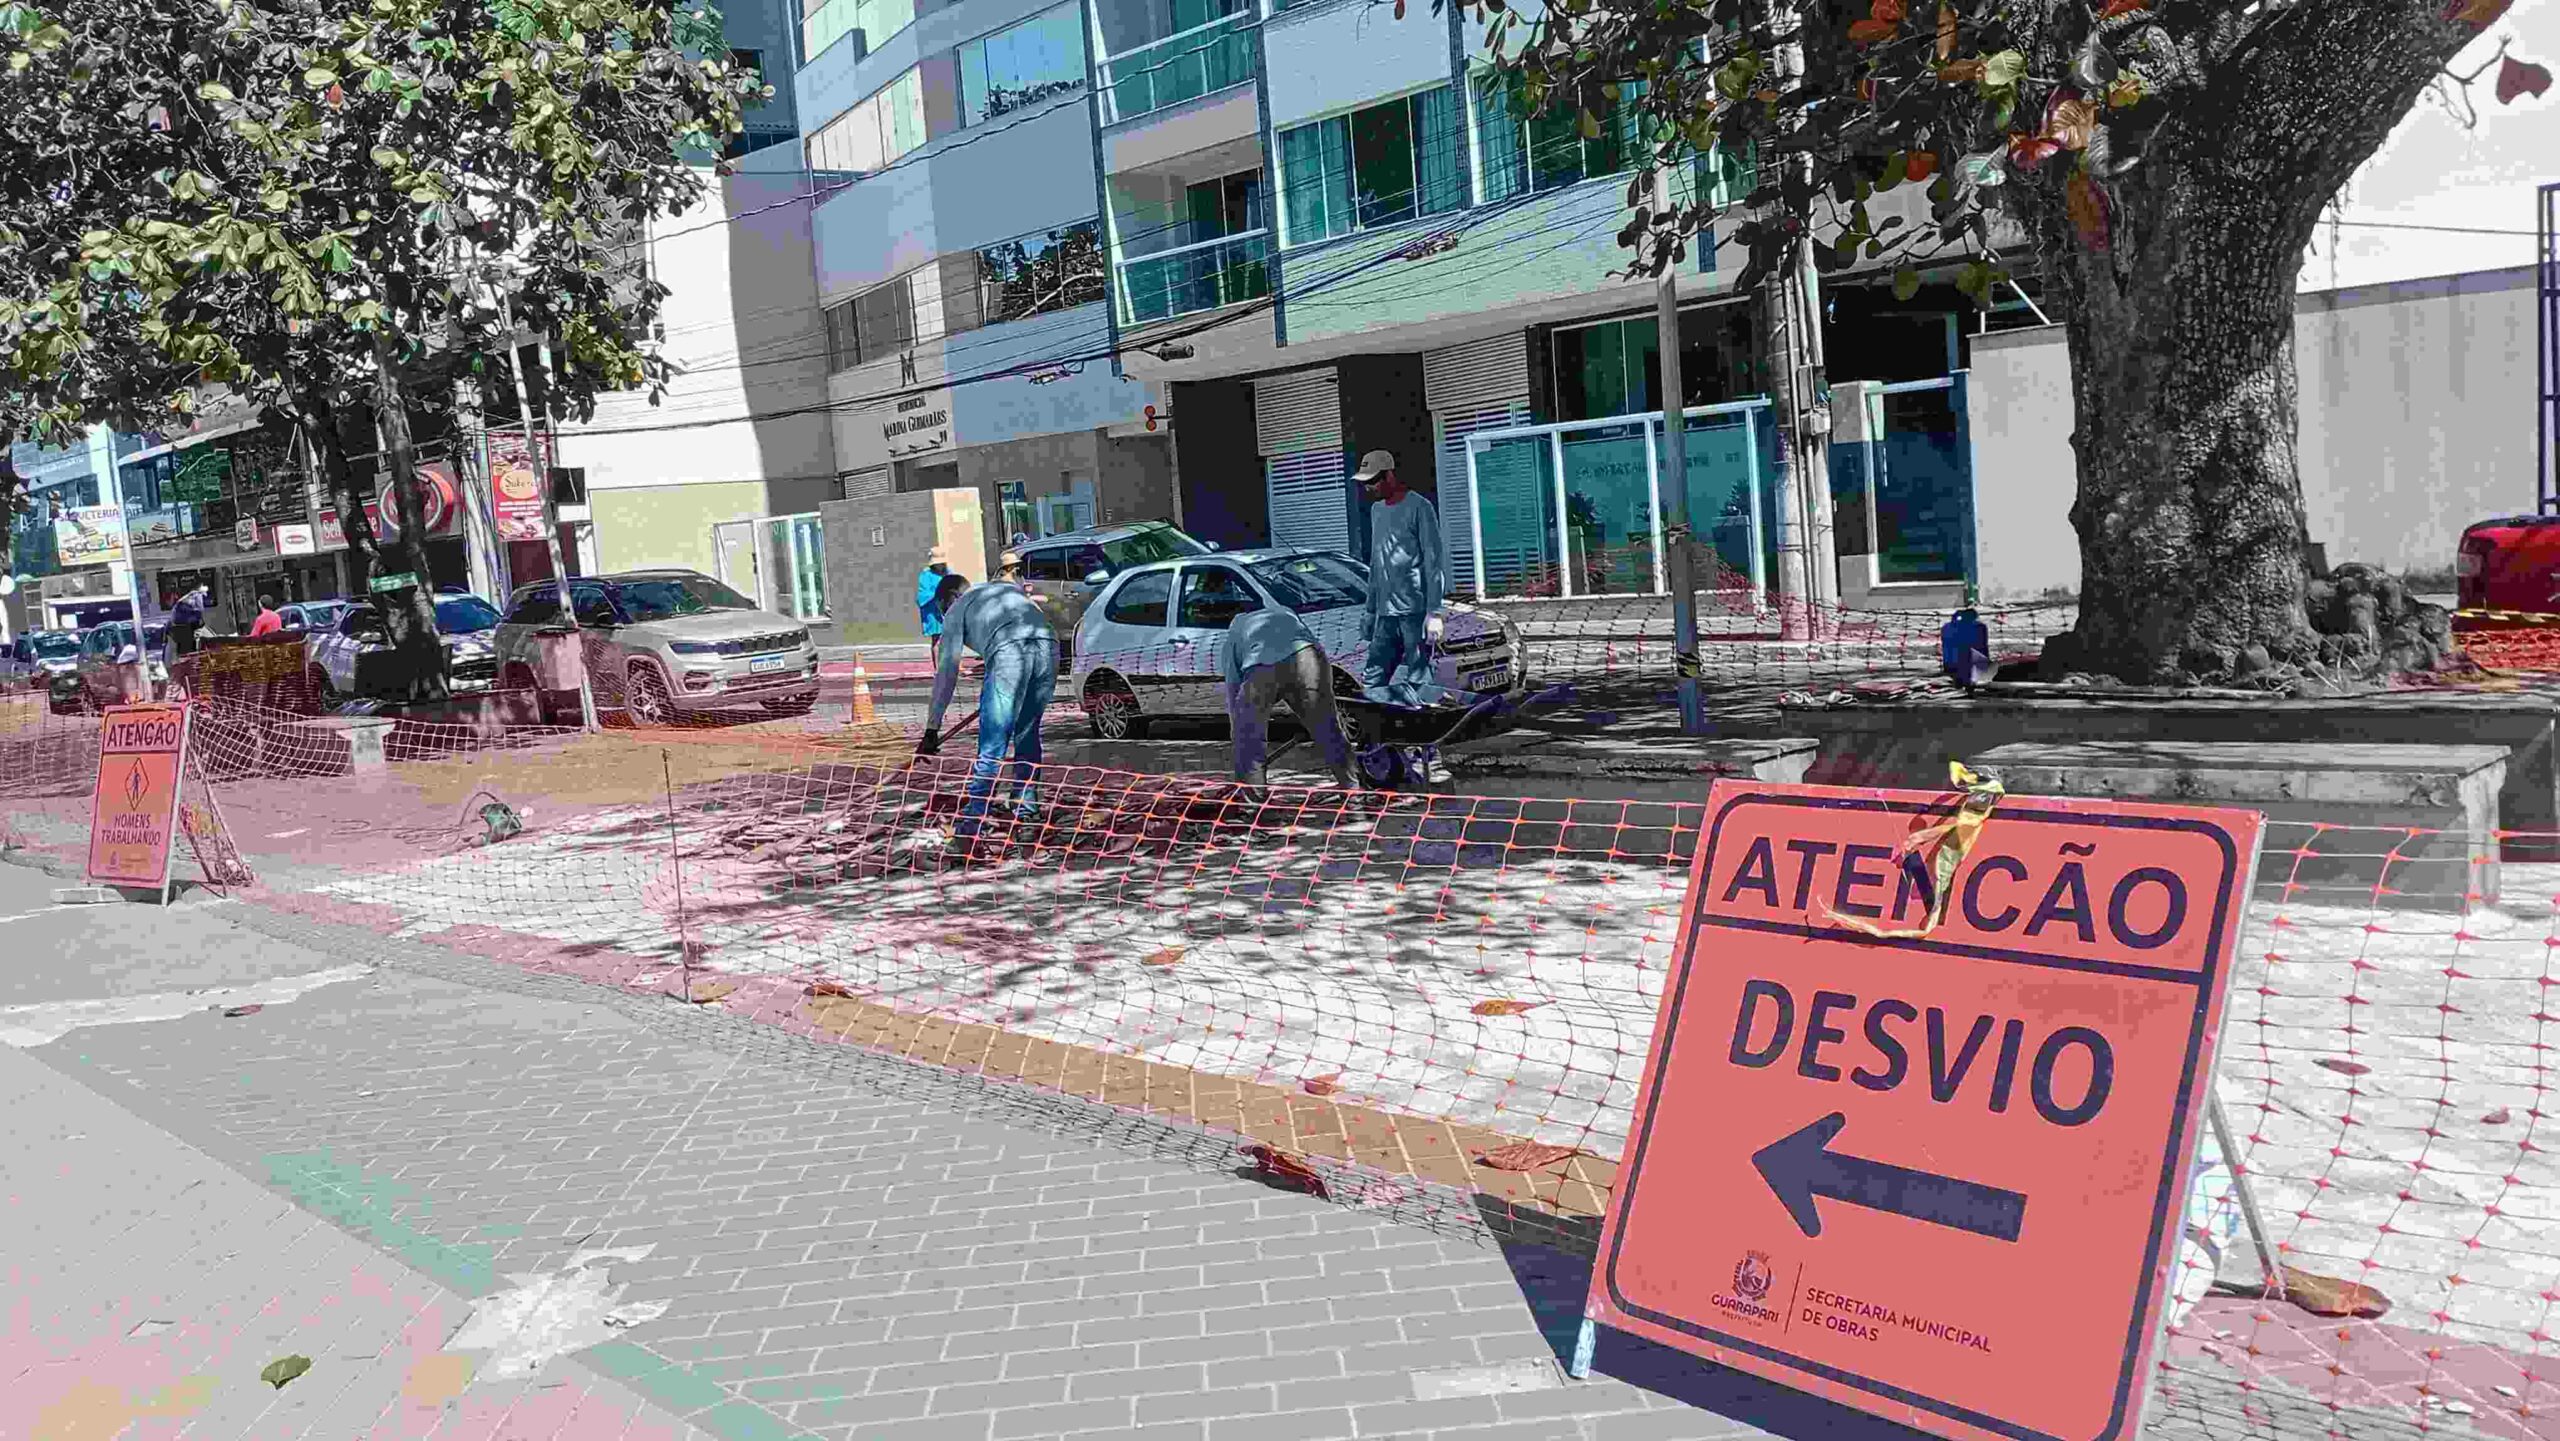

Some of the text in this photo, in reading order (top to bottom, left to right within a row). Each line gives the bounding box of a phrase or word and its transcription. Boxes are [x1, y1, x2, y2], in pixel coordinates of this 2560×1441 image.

[101, 828, 161, 846] TRABALHANDO
[114, 813, 151, 829] HOMENS
[1727, 979, 2116, 1128] DESVIO
[1711, 1294, 1780, 1323] GUARAPARI
[1806, 1287, 1992, 1354] SECRETARIA MUNICIPAL
[1801, 1308, 1879, 1343] DE OBRAS
